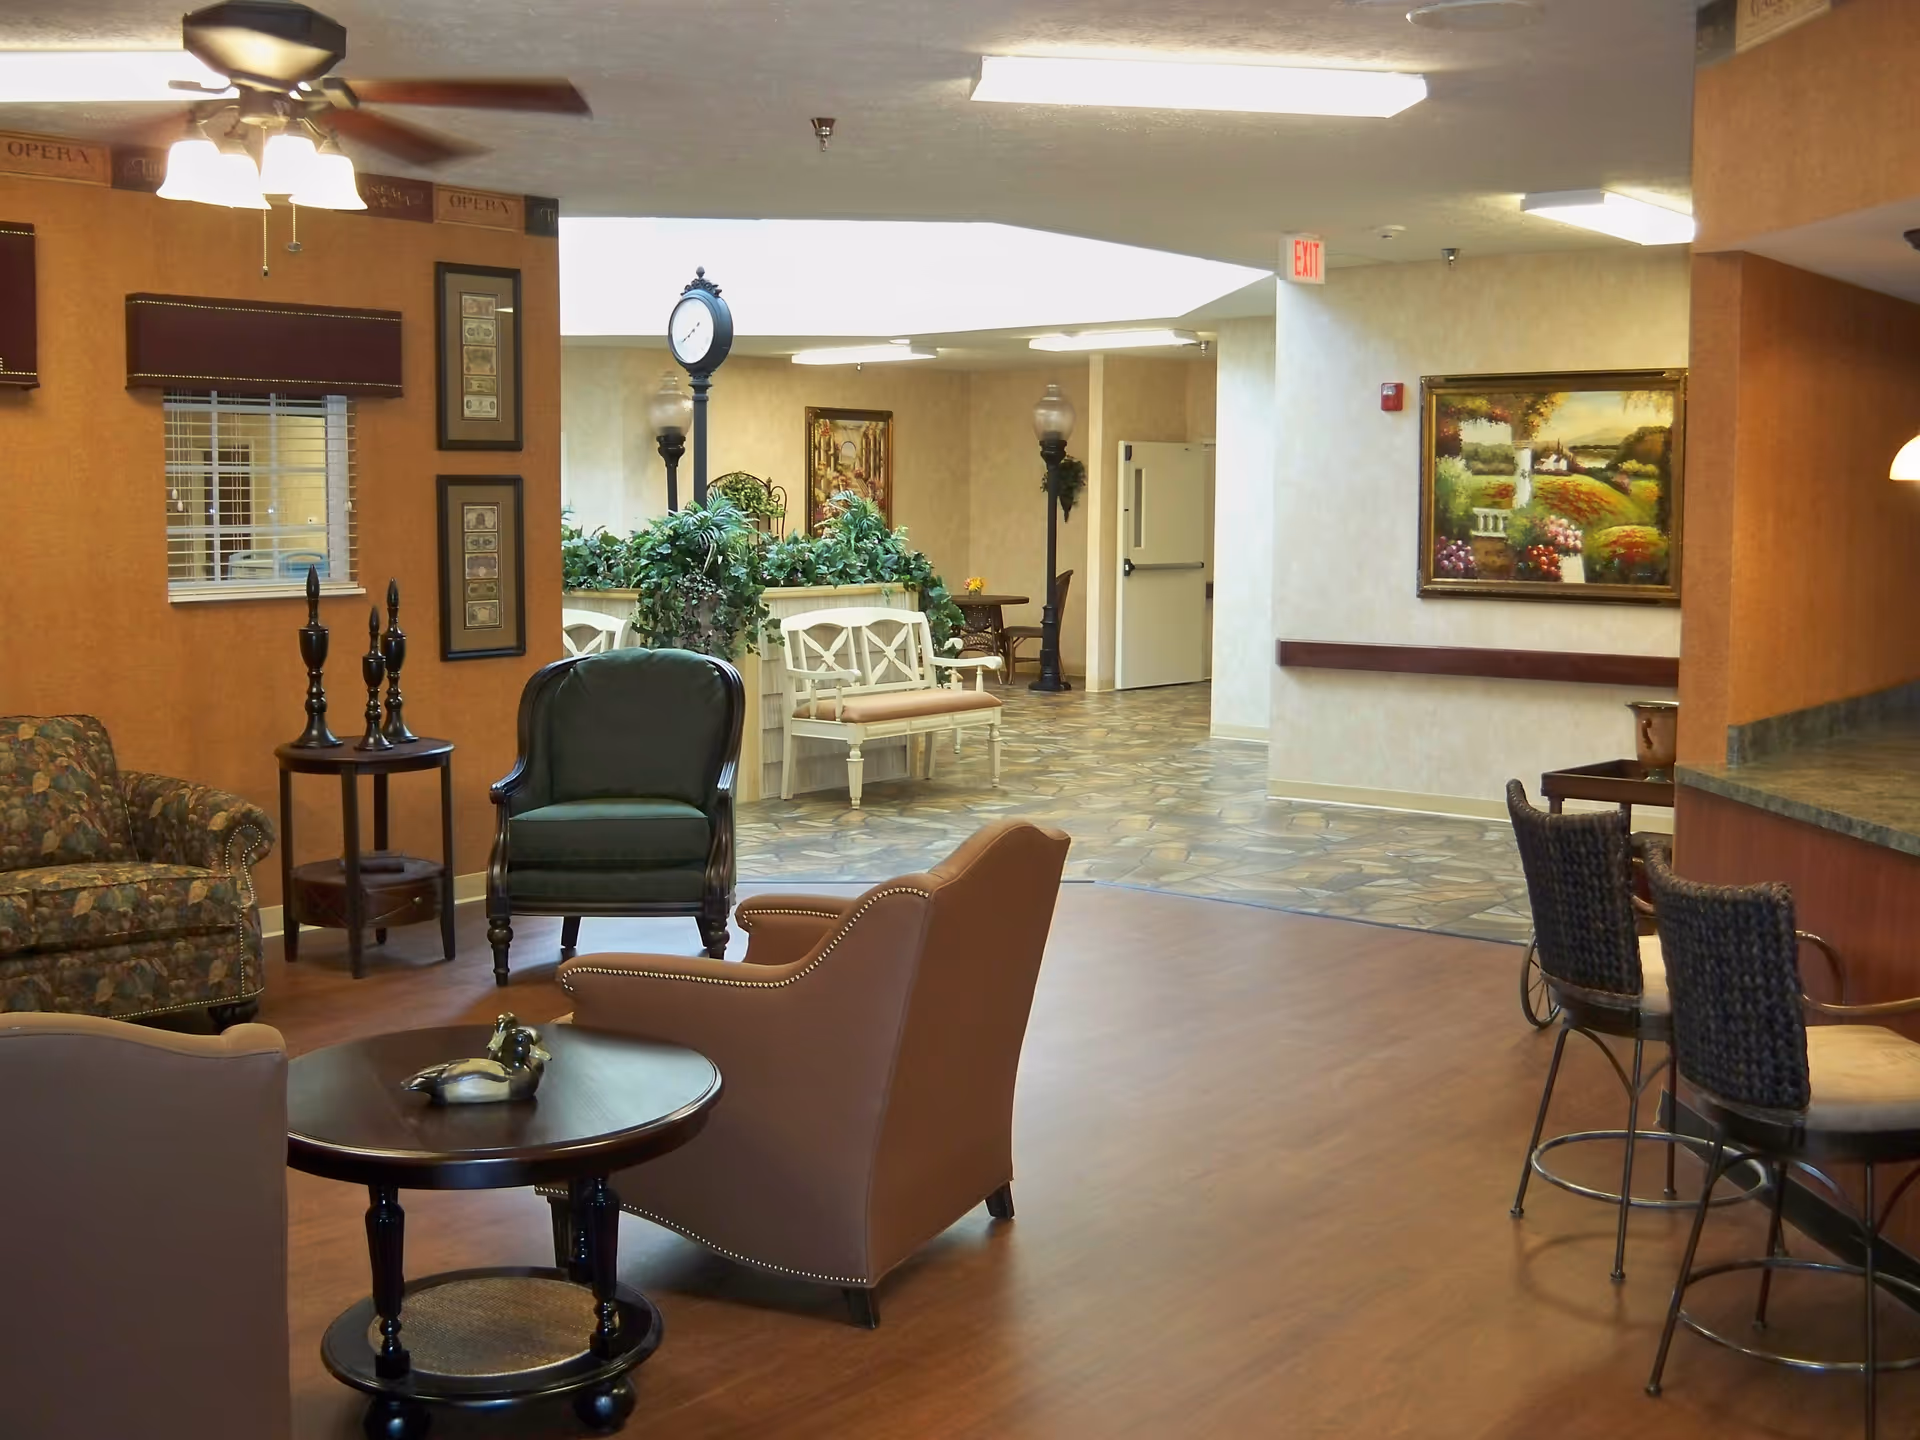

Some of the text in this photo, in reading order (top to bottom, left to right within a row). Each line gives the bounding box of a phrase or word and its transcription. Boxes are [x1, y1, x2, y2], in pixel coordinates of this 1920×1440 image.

[7, 140, 90, 164] OPERA
[449, 194, 509, 214] OPERA
[1294, 240, 1319, 280] EXIT
